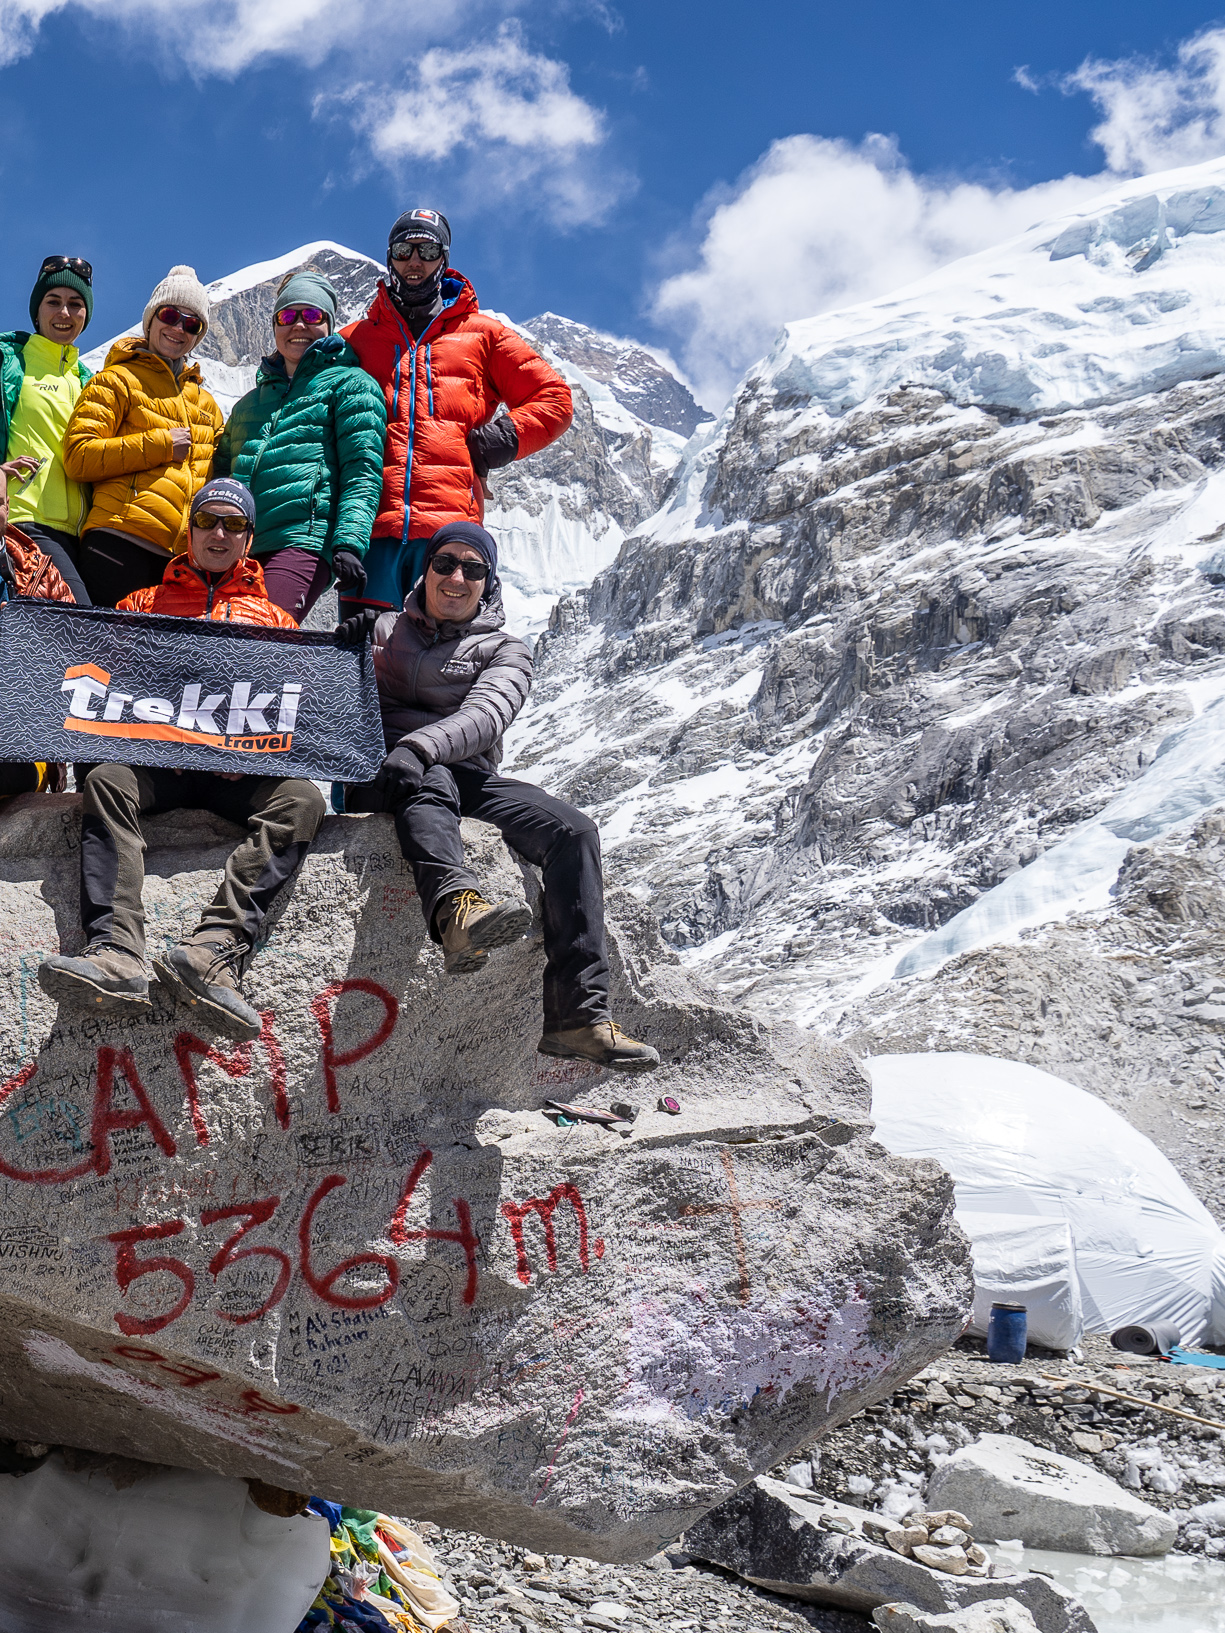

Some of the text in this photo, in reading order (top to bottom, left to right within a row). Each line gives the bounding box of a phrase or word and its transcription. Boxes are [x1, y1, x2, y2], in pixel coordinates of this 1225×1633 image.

[208, 488, 244, 504] trekki
[61, 662, 303, 735] trekki
[104, 1150, 479, 1335] 5364
[306, 1329, 369, 1353] Bahrain
